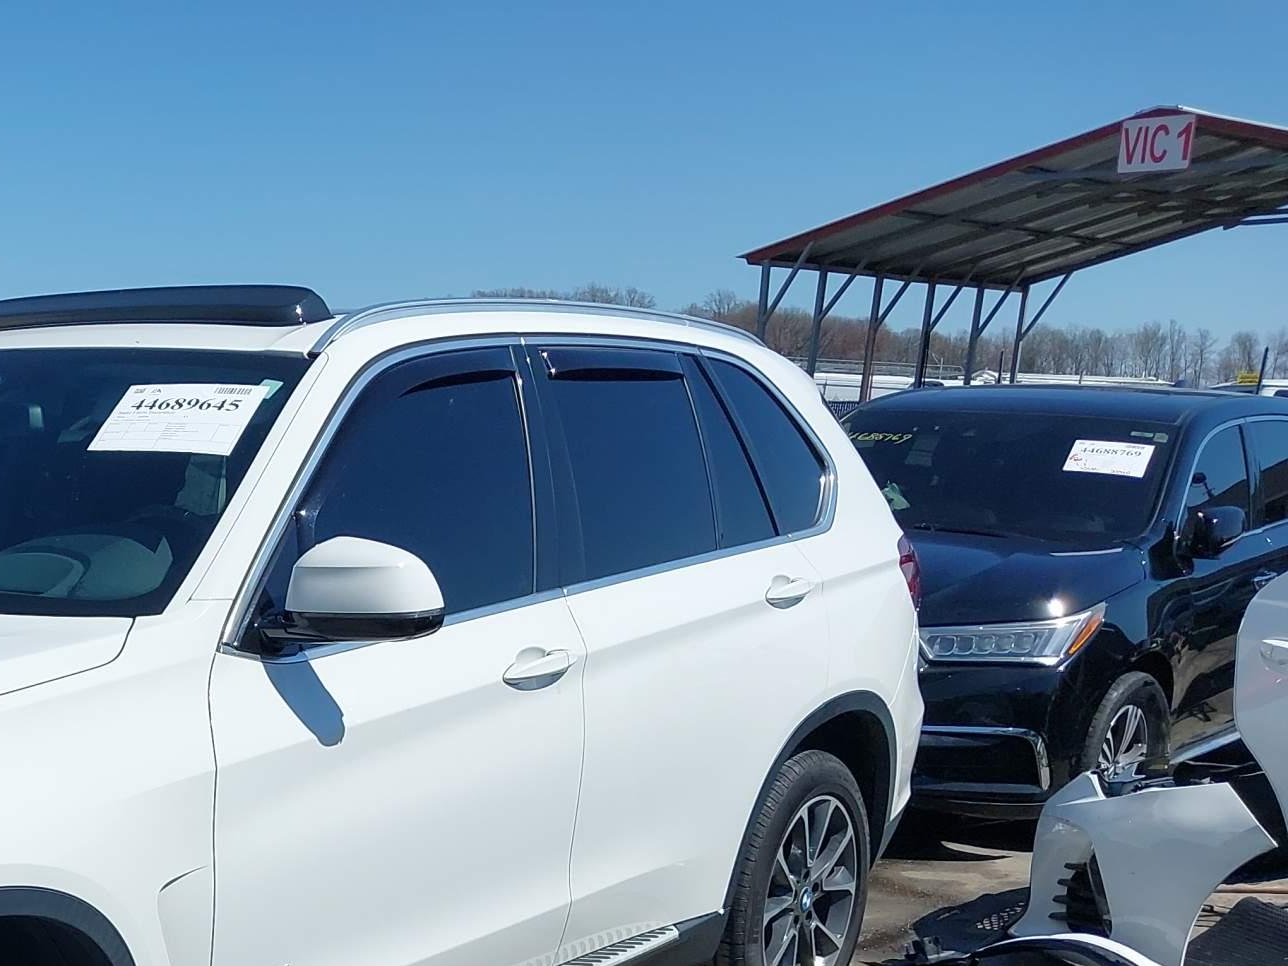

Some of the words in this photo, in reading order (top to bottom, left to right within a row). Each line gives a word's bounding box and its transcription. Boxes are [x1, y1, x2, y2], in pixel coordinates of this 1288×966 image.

[1124, 125, 1170, 165] VIC
[1177, 122, 1193, 161] 1
[131, 398, 243, 412] 44689645
[1081, 447, 1142, 457] 44688769
